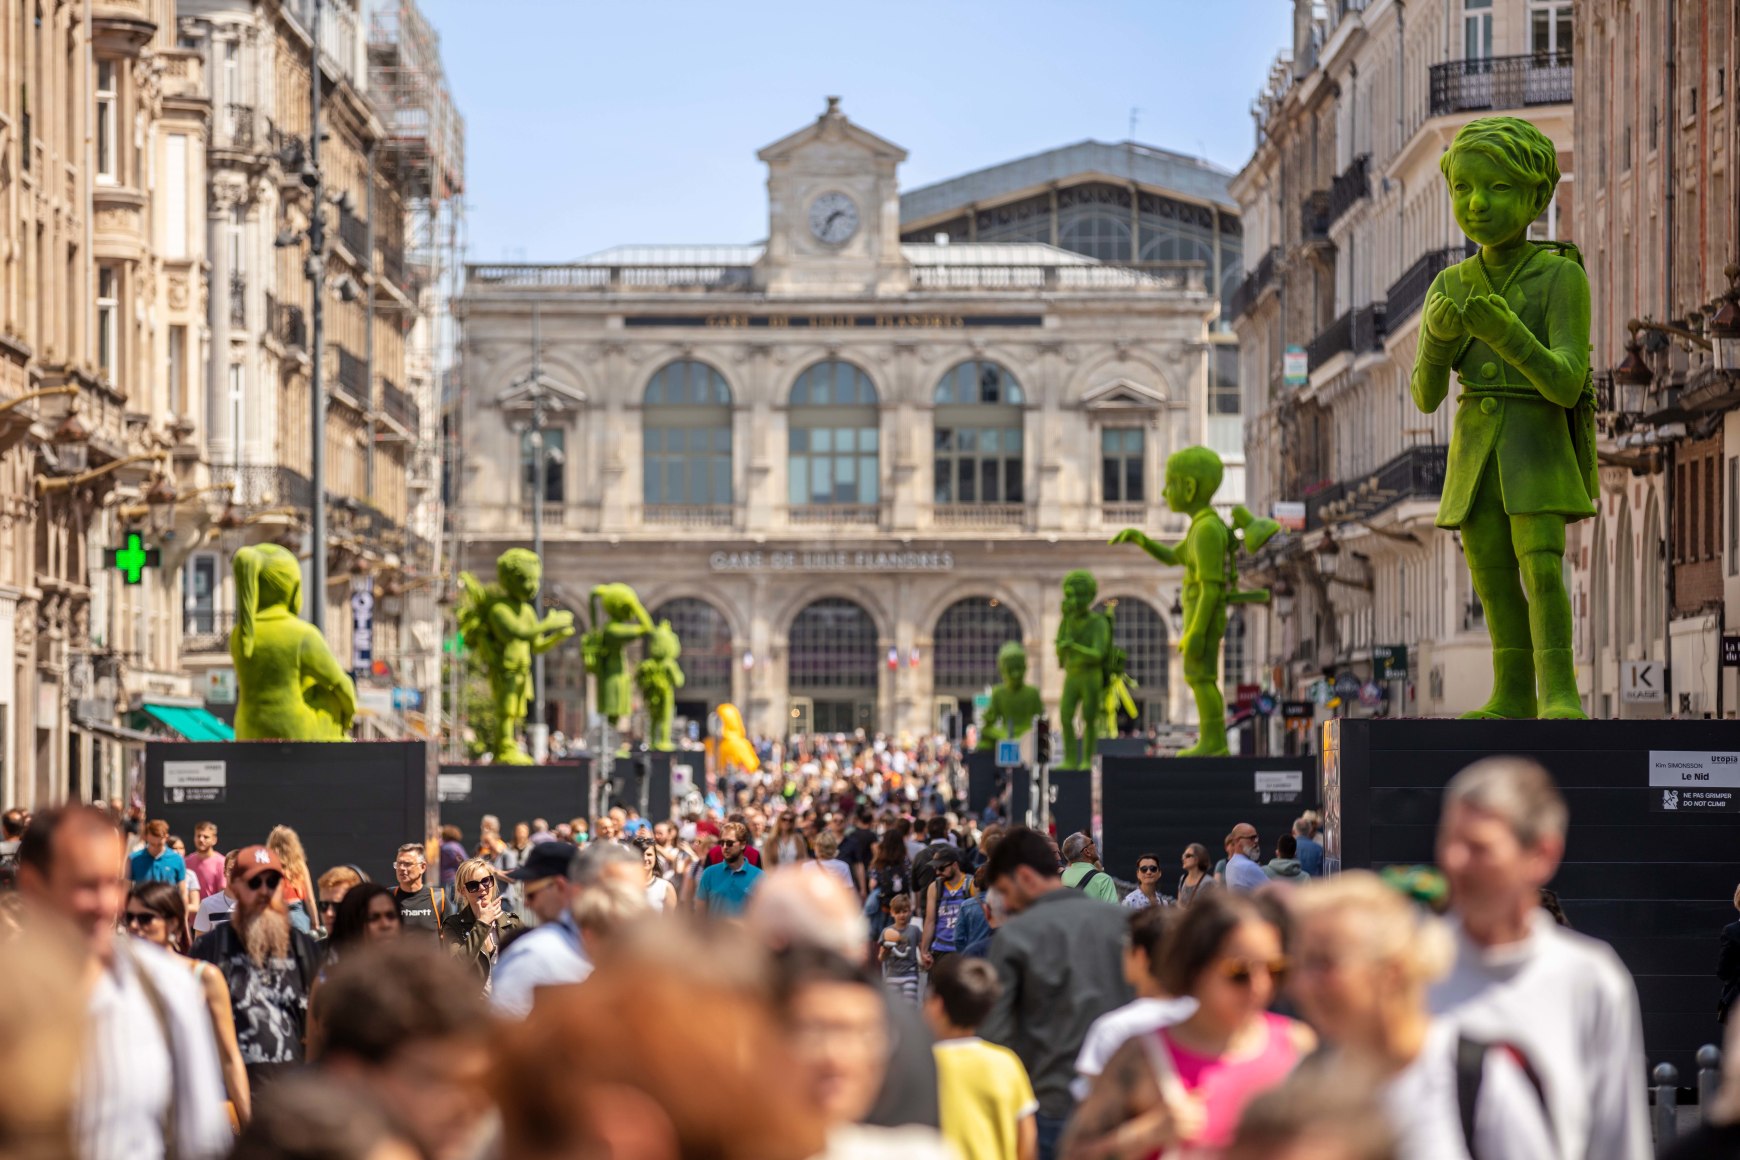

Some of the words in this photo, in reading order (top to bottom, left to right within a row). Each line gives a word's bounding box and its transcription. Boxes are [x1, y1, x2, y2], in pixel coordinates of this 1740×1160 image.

[770, 551, 796, 569] DE
[1711, 756, 1738, 764] Utopia
[400, 908, 432, 917] rhartt
